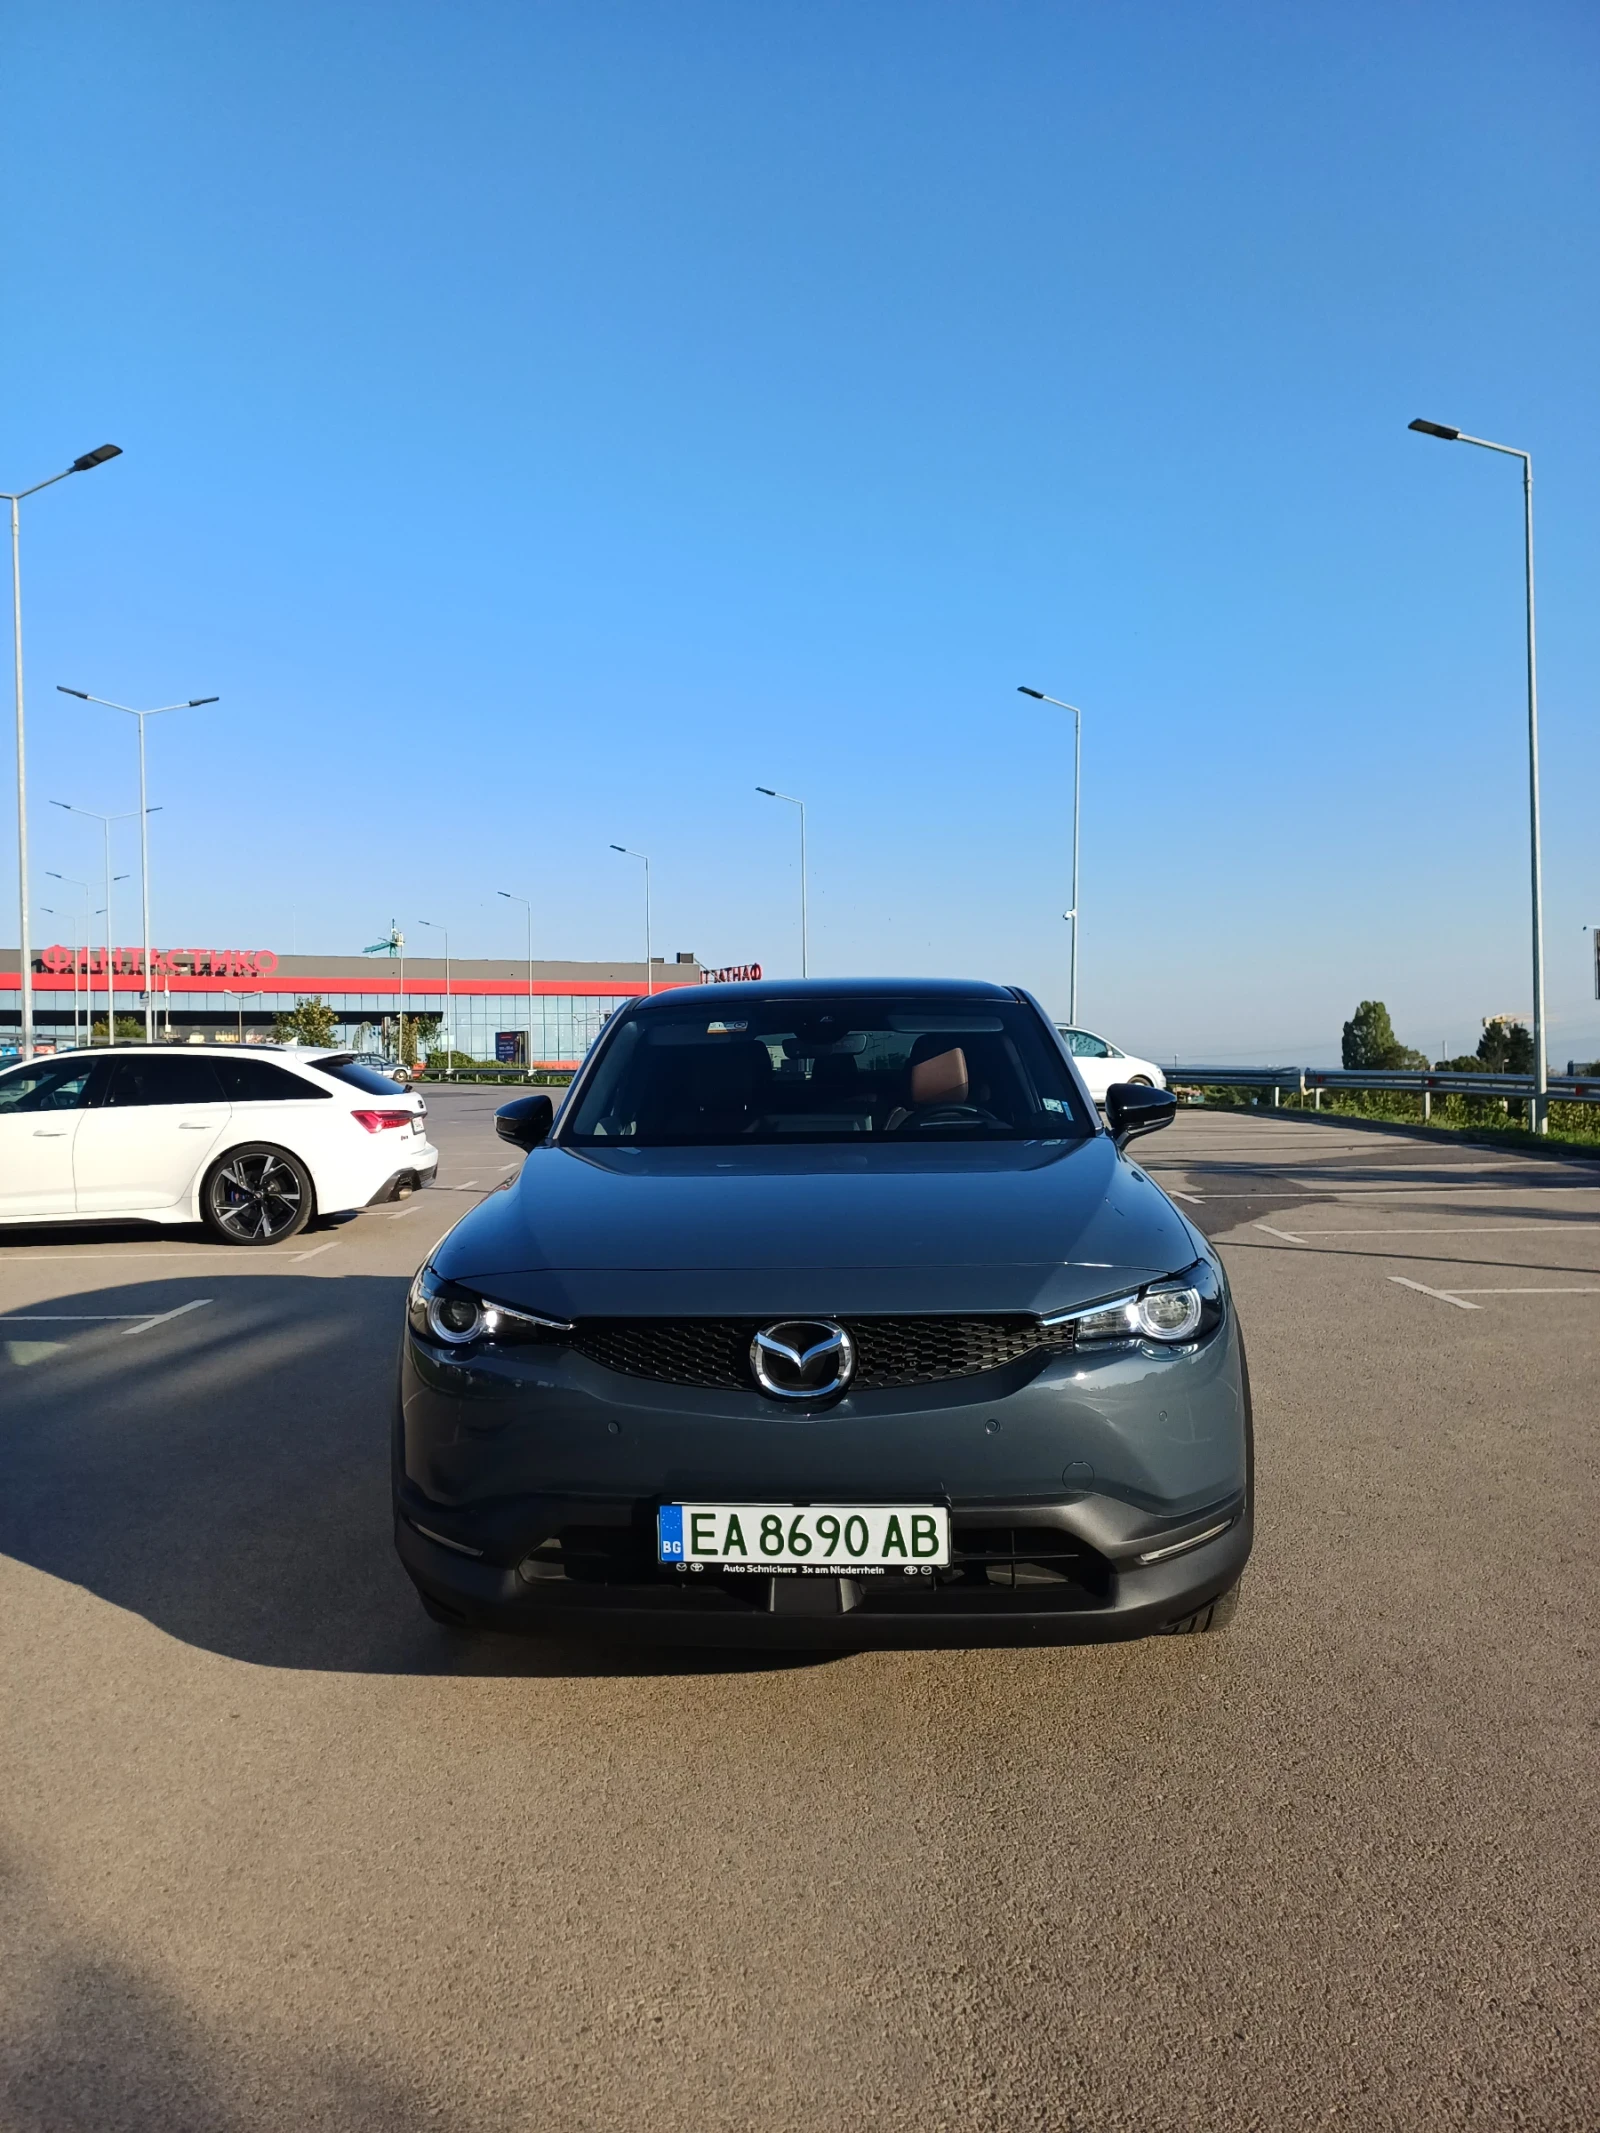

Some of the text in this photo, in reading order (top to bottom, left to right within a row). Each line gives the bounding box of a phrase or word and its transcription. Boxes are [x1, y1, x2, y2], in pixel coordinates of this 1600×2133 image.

[42, 945, 278, 973] ФАНТАСТИКО
[691, 1513, 939, 1557] EA 8690 AB
[663, 1541, 681, 1553] BG
[723, 1564, 745, 1573] Auto
[747, 1564, 797, 1574] Schnickers
[802, 1566, 813, 1574] 3x
[830, 1566, 885, 1575] Niederrhein
